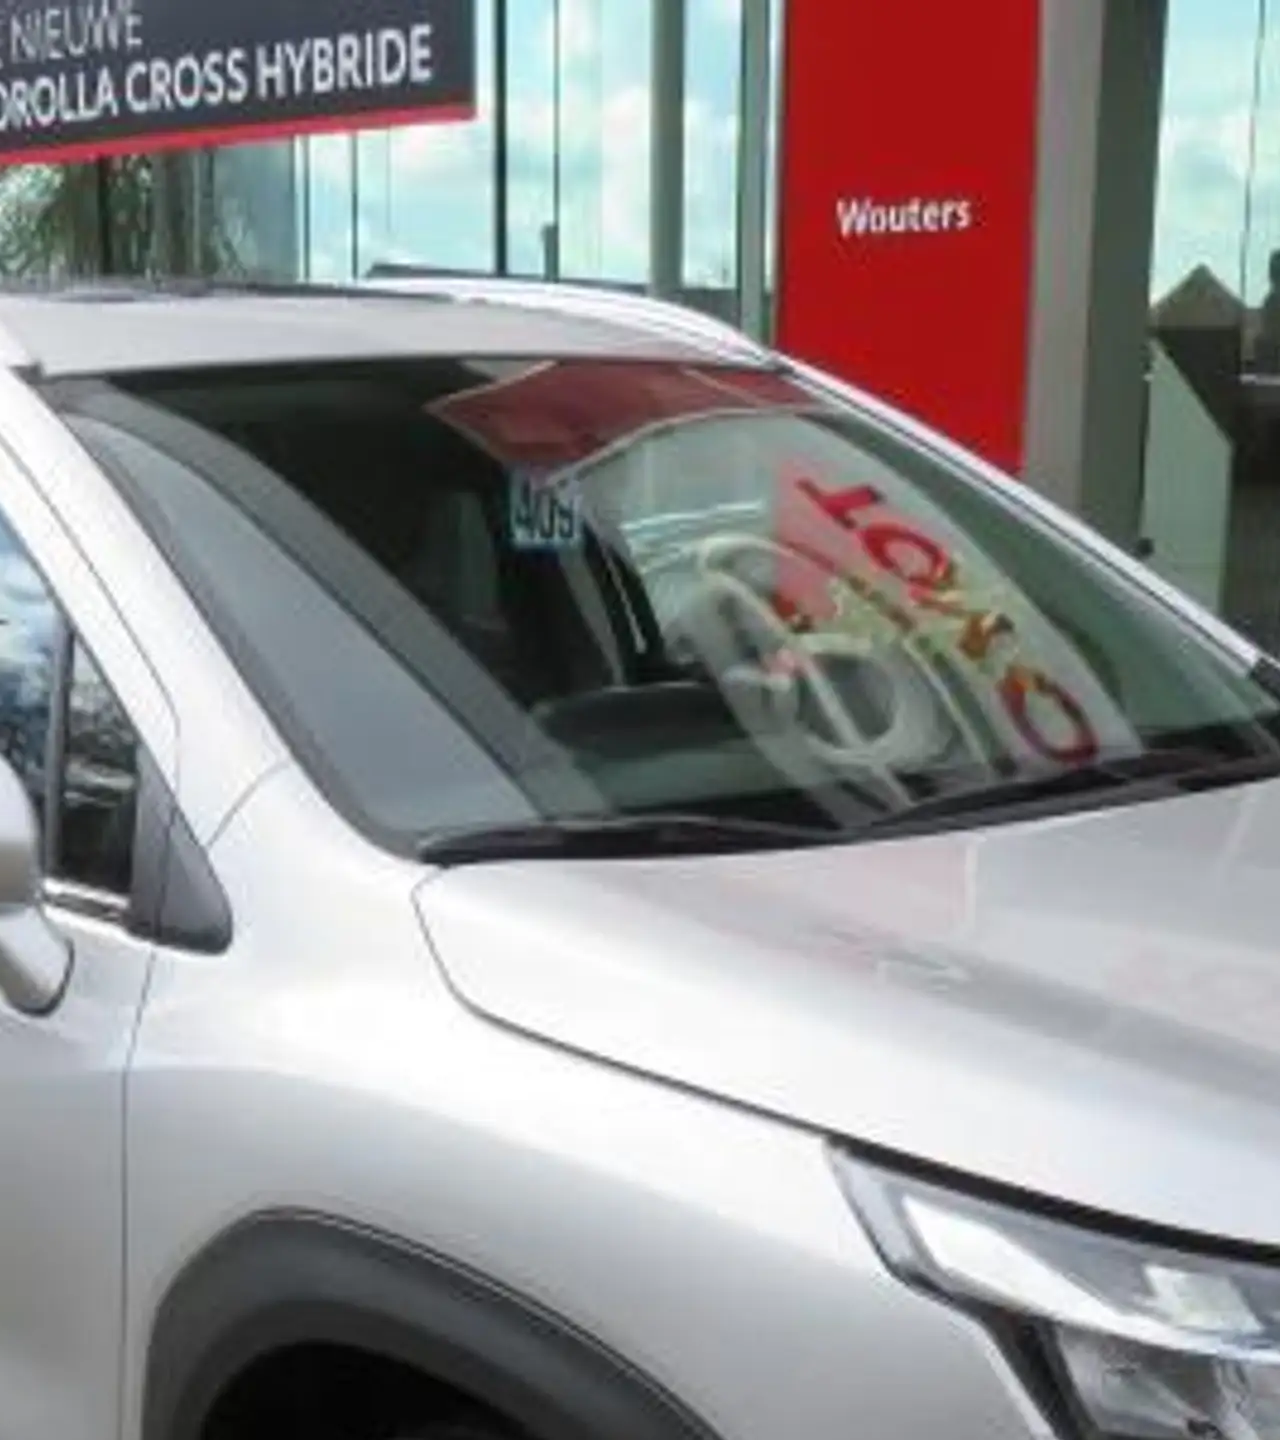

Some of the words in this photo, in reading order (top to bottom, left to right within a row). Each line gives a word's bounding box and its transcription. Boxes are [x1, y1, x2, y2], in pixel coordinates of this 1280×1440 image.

[11, 1, 142, 63] NIEUWE
[125, 48, 248, 112] CROSS
[255, 23, 432, 98] HYBRIDE
[837, 197, 972, 239] Wouters
